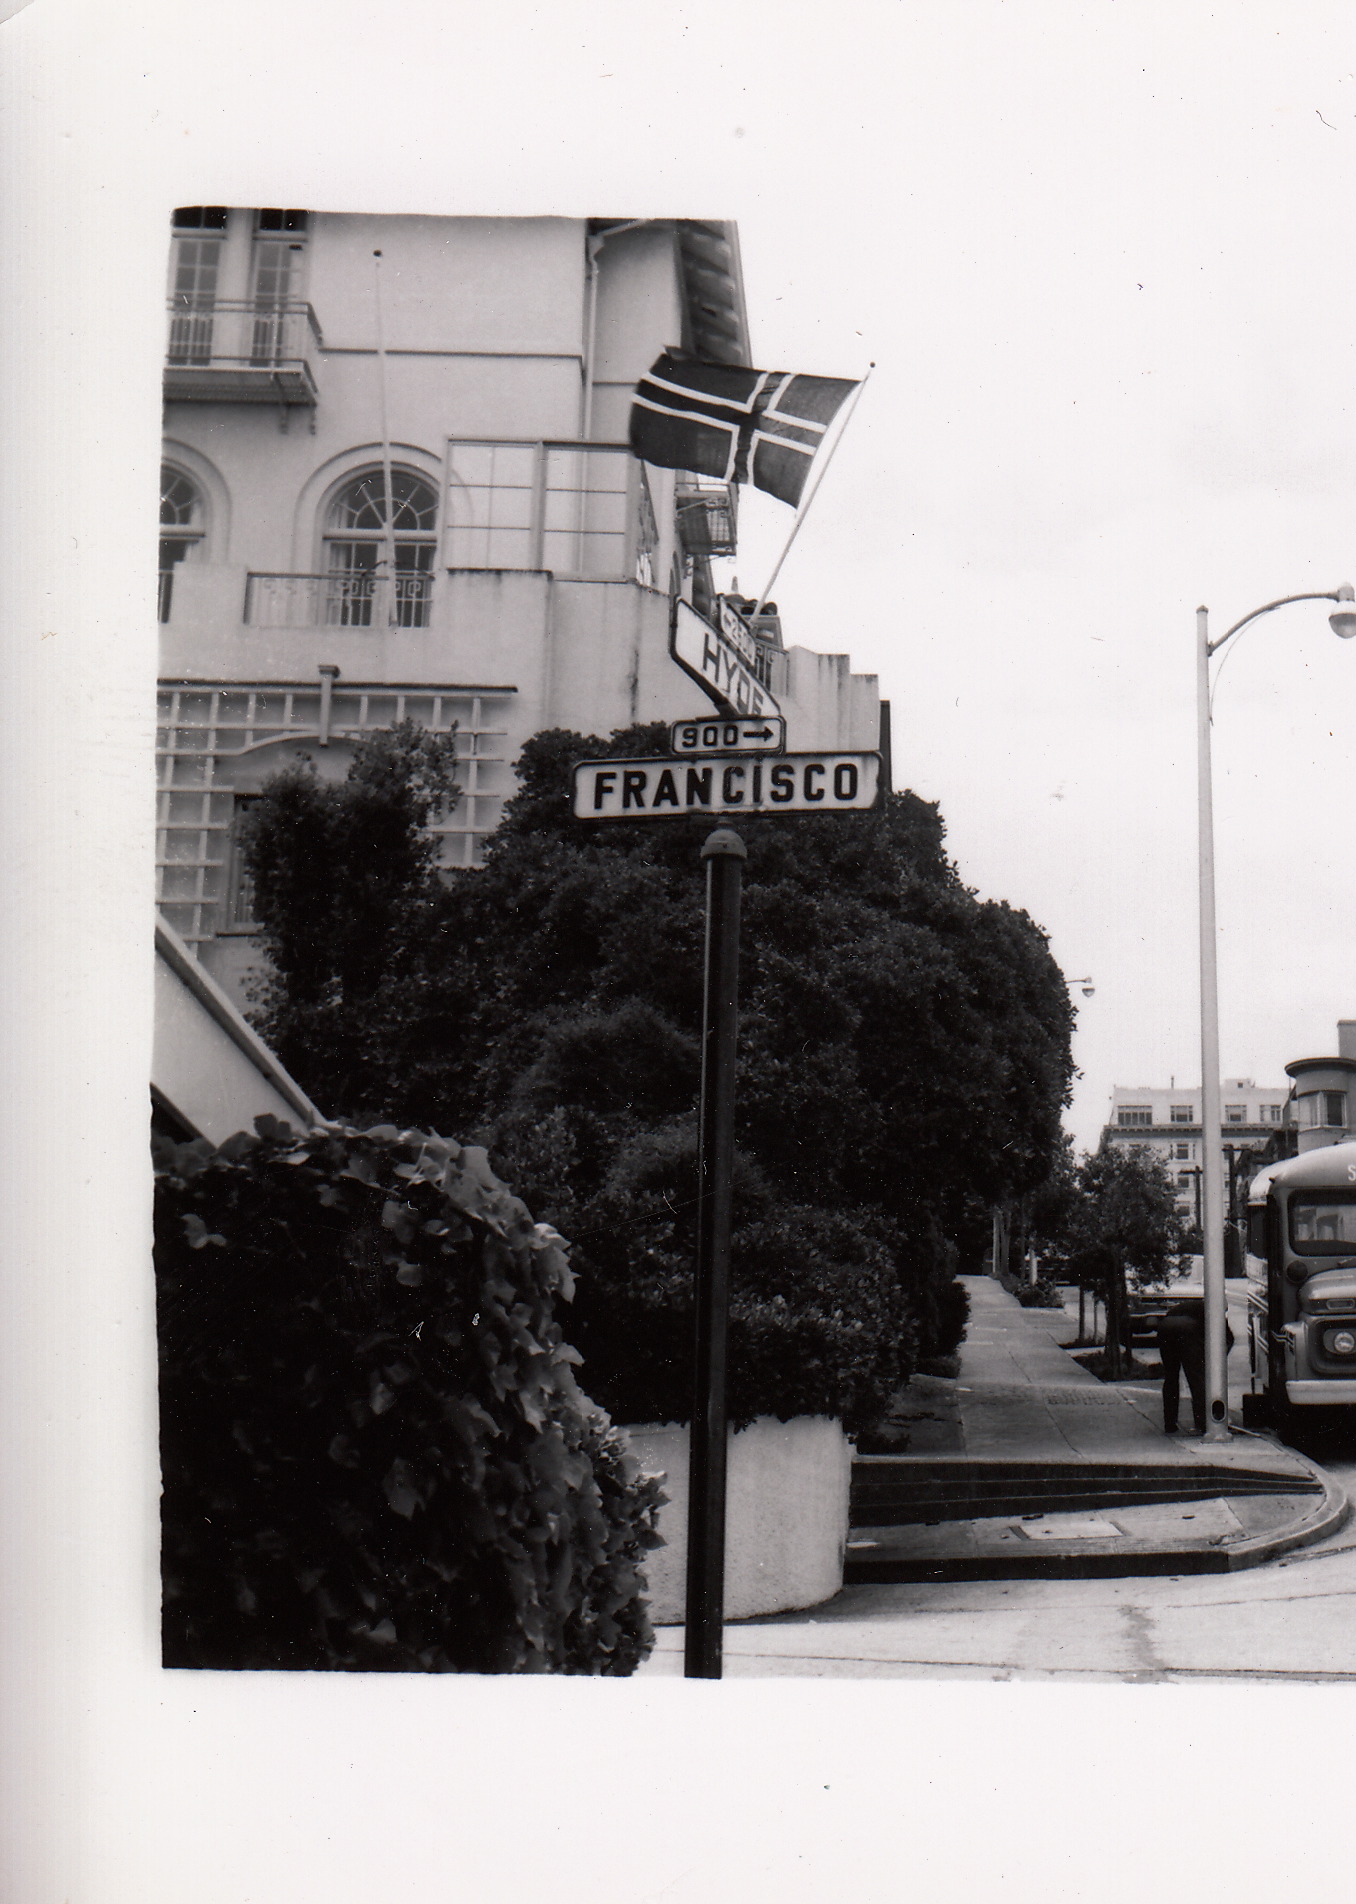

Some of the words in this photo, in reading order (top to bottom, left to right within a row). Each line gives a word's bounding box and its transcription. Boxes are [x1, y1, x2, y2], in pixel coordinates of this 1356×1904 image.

[702, 632, 764, 716] HYDE
[681, 724, 740, 749] 900
[593, 762, 859, 811] FRANCISCO
